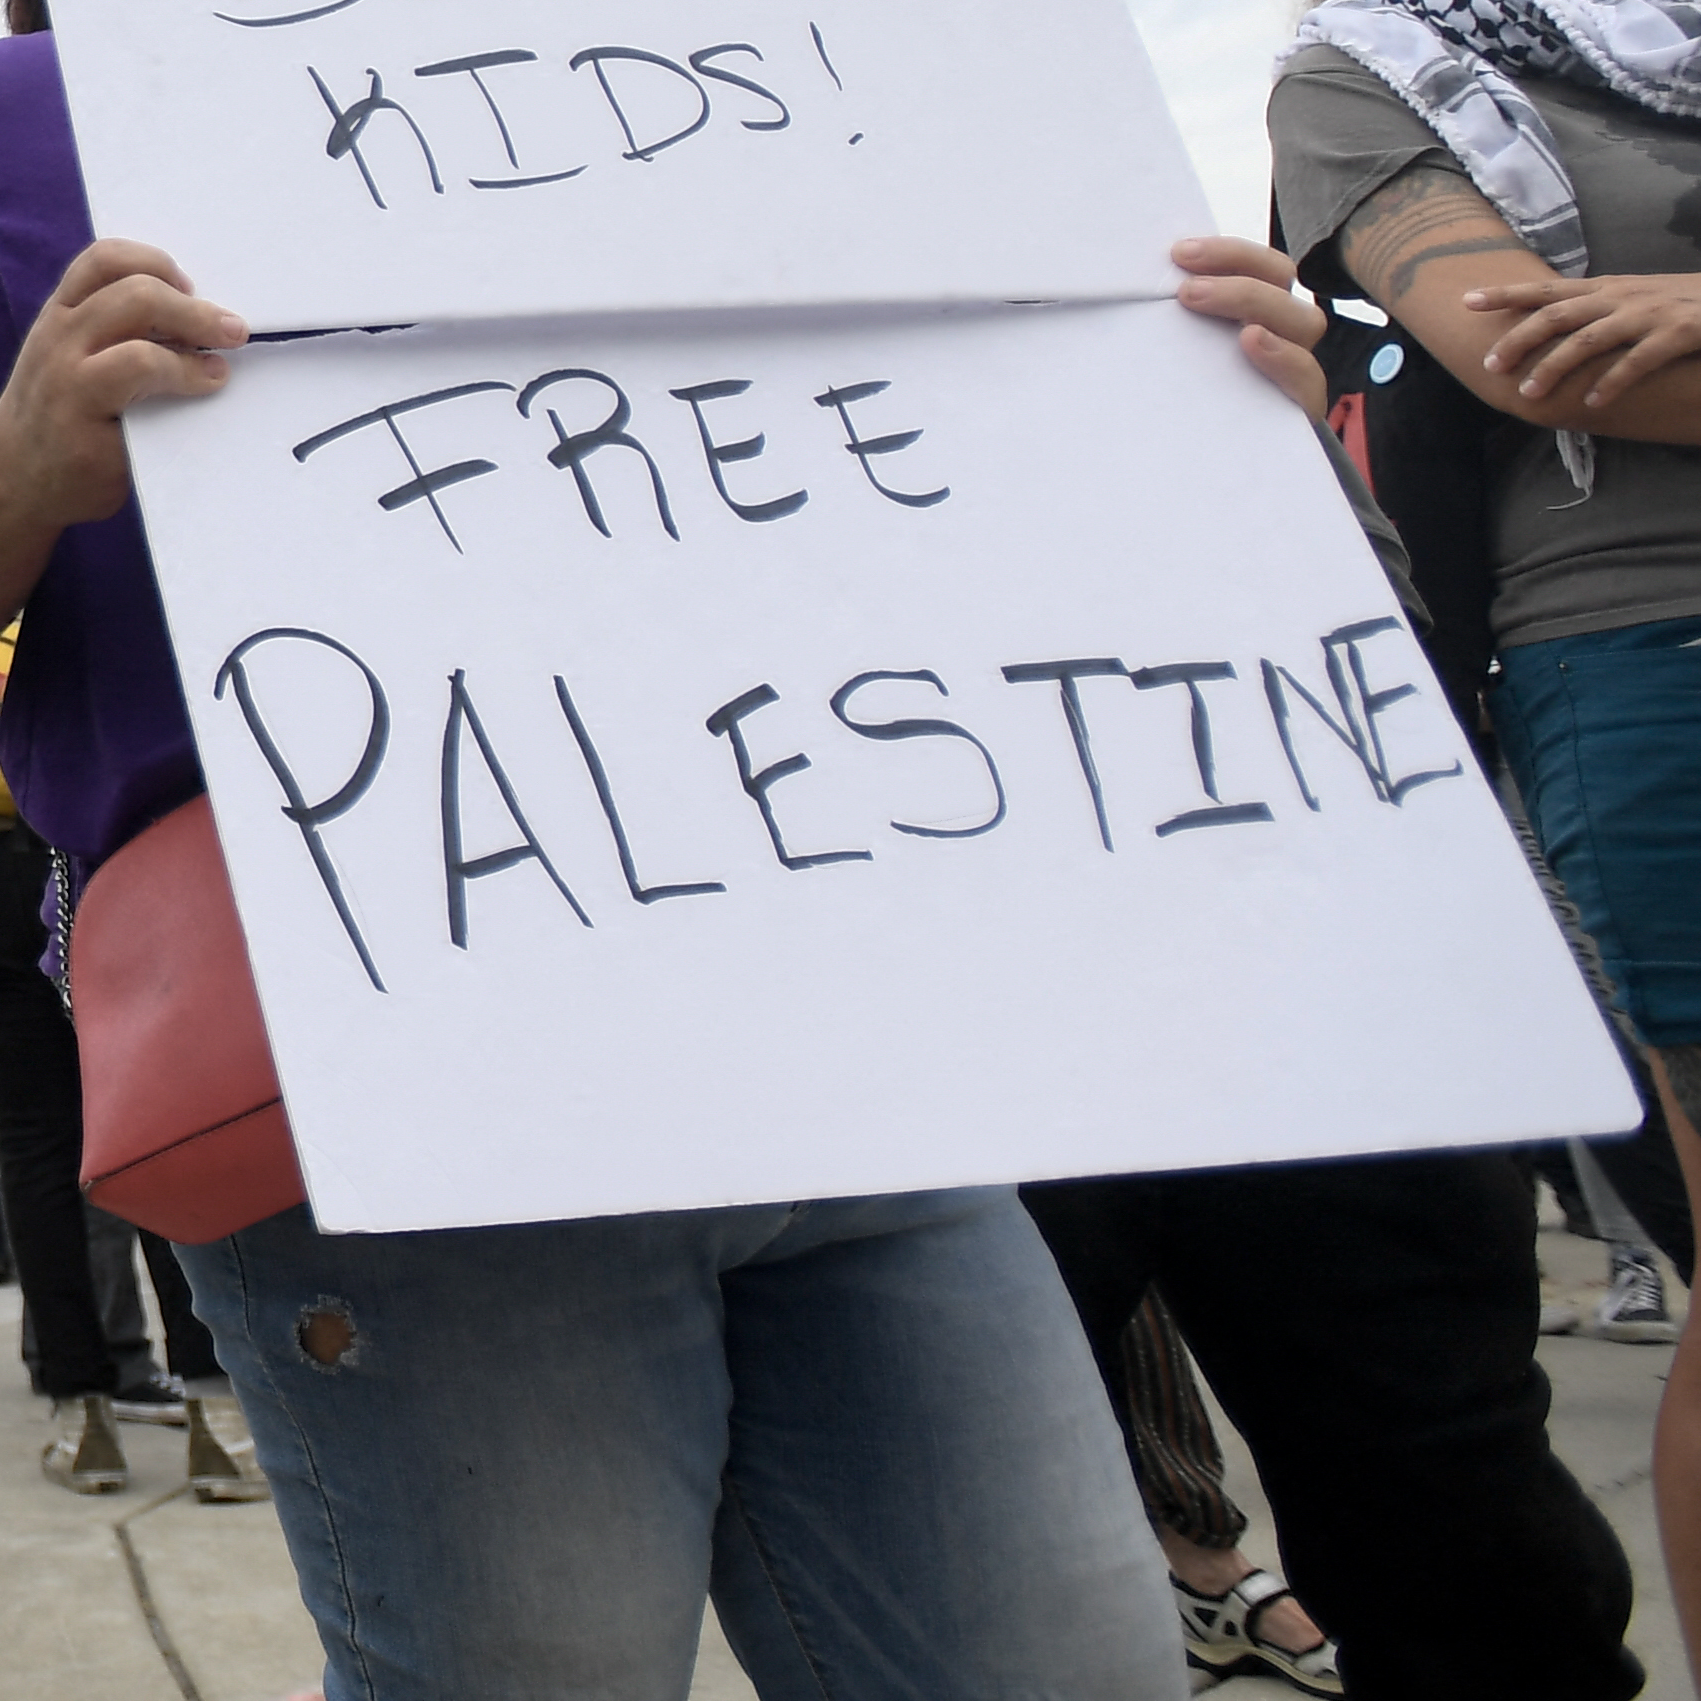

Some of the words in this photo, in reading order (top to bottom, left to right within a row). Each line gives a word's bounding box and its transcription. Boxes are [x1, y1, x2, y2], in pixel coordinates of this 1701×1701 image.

[306, 20, 864, 211] KIDS!
[293, 366, 952, 555] FREE
[213, 615, 1463, 996] PALESTINE
